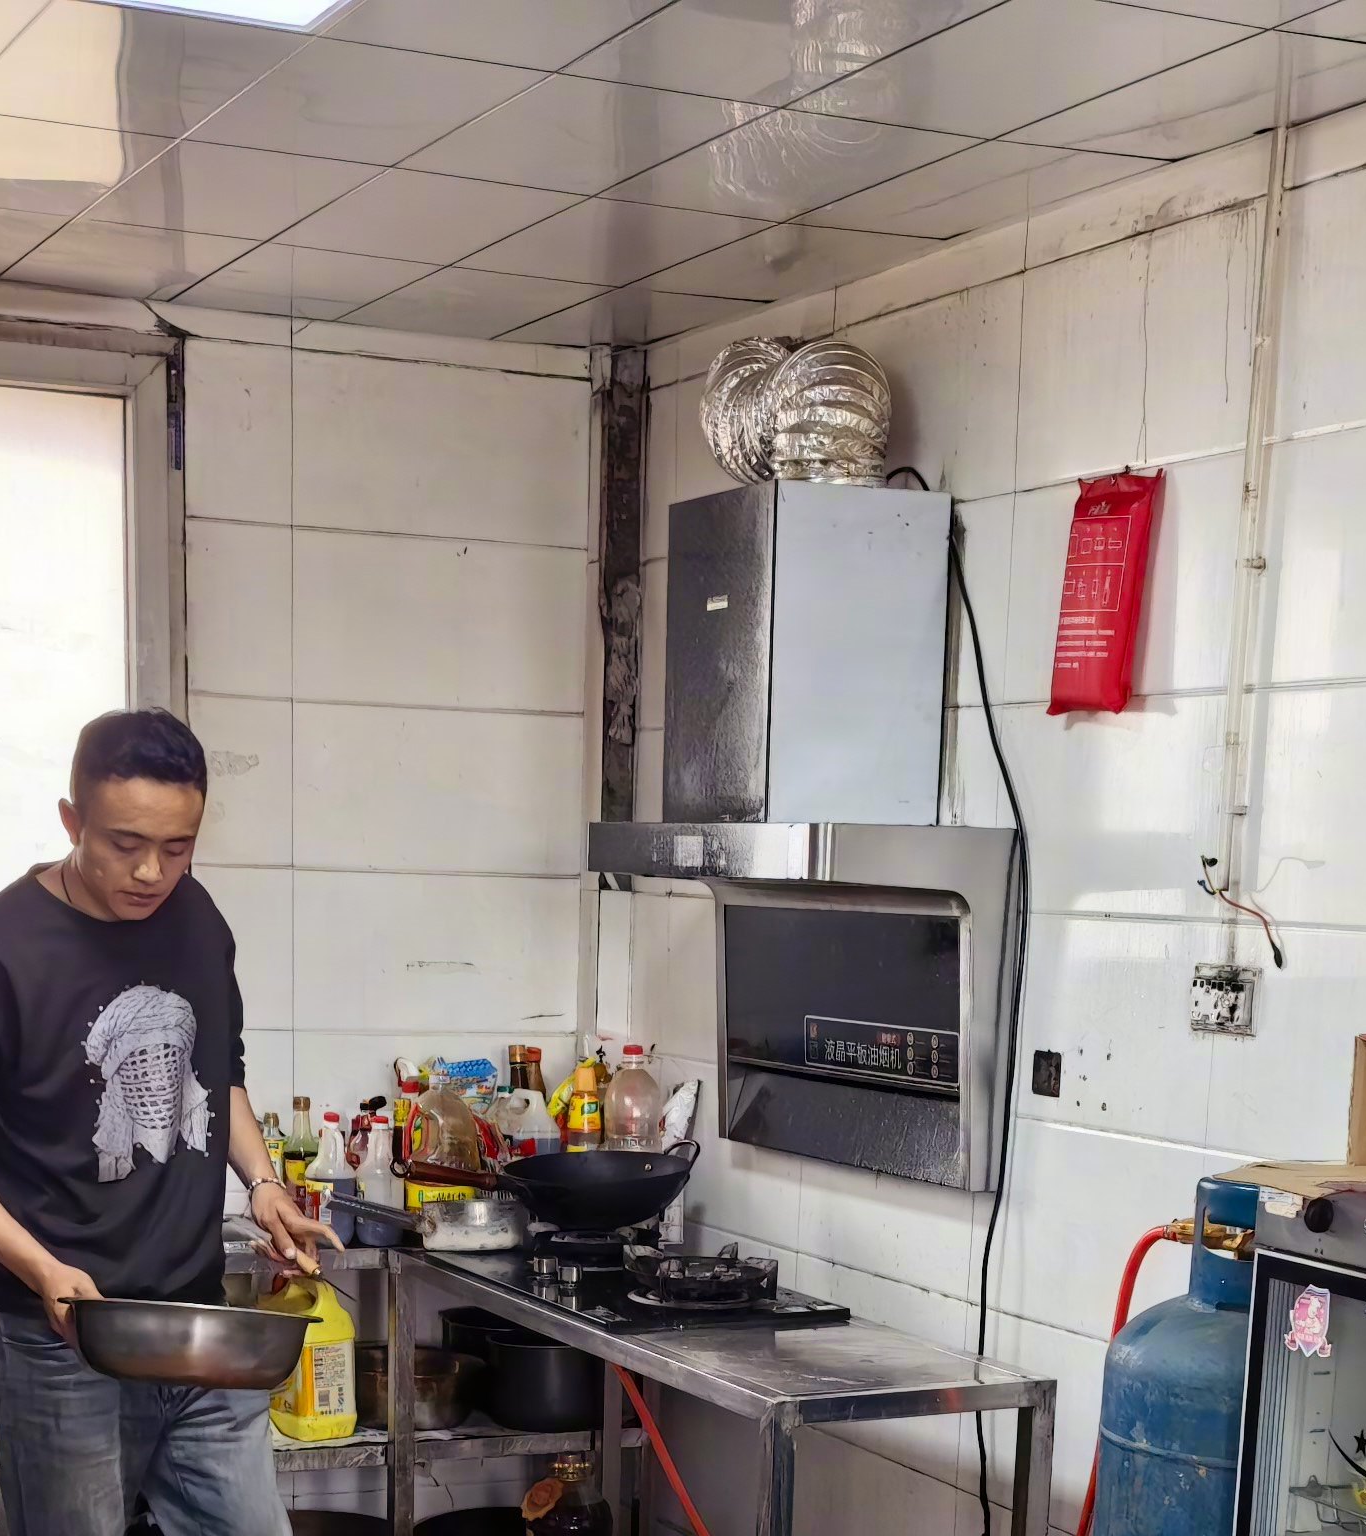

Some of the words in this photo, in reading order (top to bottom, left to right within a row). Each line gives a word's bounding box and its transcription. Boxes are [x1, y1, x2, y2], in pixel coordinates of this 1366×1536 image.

[824, 1039, 902, 1069] 液晶平板油烟机
